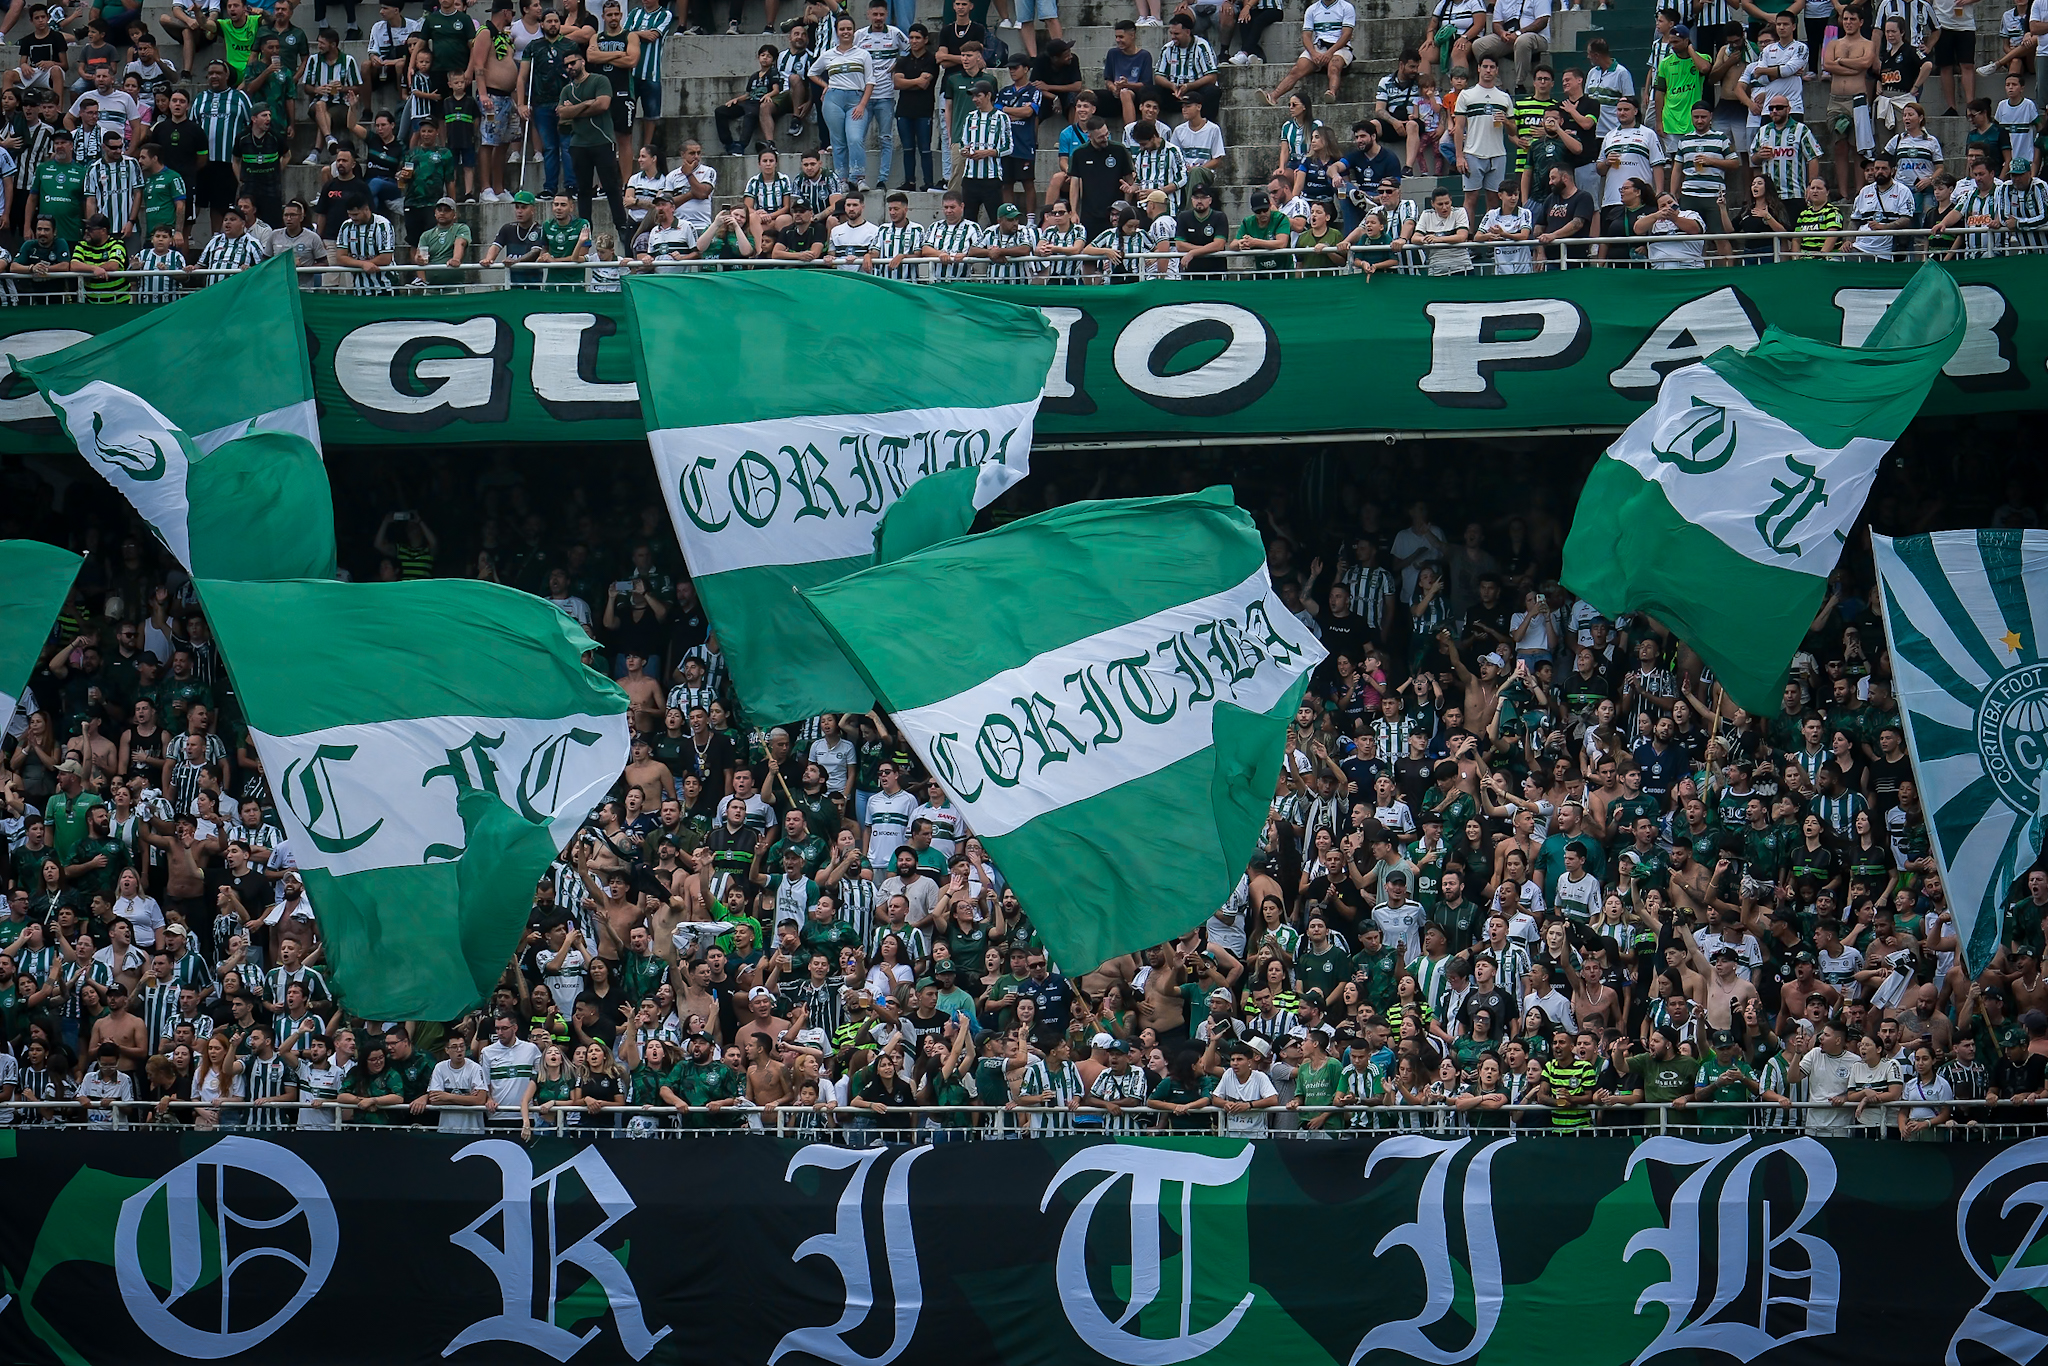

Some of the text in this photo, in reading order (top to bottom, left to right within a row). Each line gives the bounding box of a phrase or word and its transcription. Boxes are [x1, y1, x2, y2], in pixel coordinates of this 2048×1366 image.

[1773, 148, 1794, 158] NYO
[1901, 162, 1927, 170] CAIXA
[929, 592, 1302, 803] CORITIBA
[1982, 699, 2012, 784] CORITIBA
[89, 1113, 113, 1122] CAIX
[0, 1134, 2048, 1366] ORITIB
